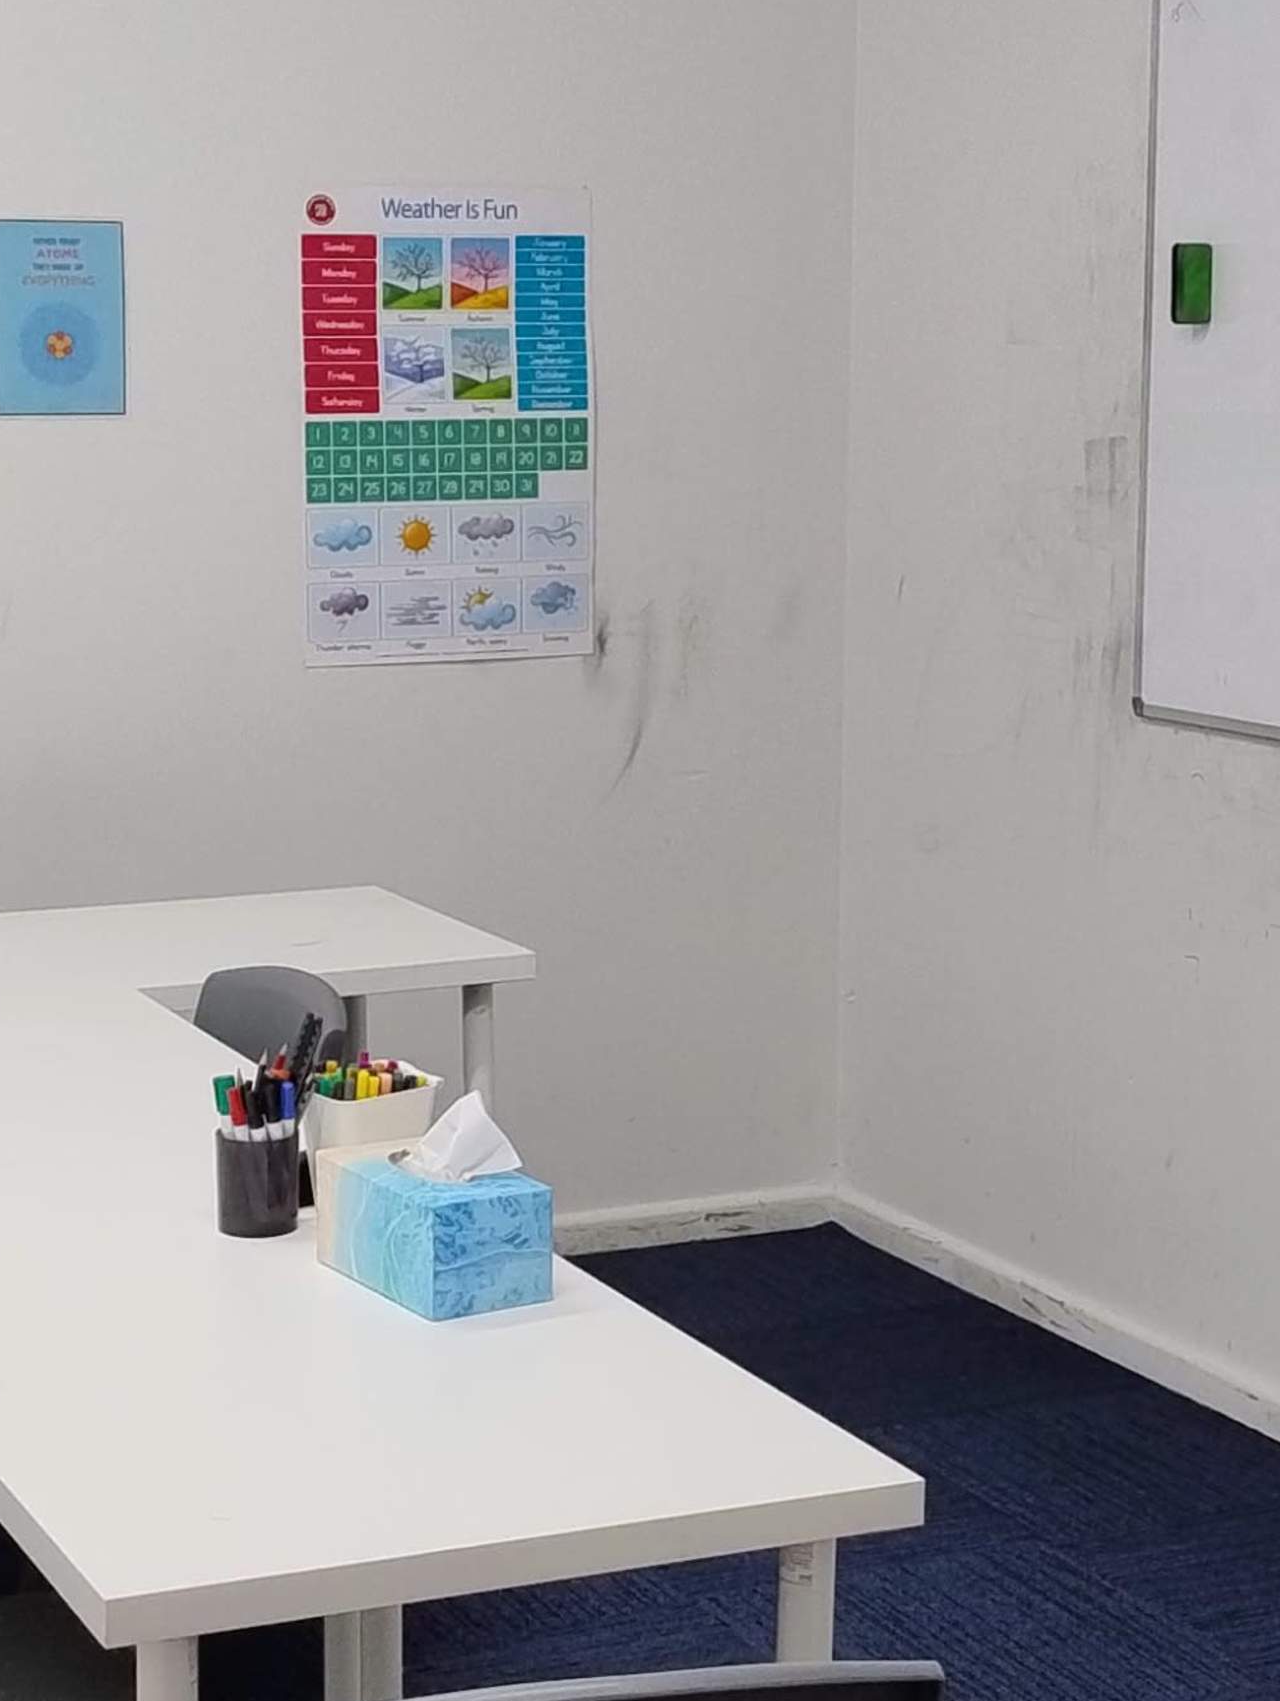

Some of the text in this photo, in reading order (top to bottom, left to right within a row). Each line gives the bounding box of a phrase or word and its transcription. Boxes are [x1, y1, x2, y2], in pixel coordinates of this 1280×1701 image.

[381, 197, 518, 220] Weather Is Fun
[341, 427, 349, 441] 2
[367, 426, 376, 440] 3
[393, 425, 403, 440] 4
[419, 425, 429, 439] 5
[444, 424, 454, 439] 6
[470, 425, 480, 439] 7
[497, 424, 505, 438] 8
[521, 423, 531, 438] 9
[544, 423, 558, 437] 10
[312, 455, 325, 469] 12
[391, 453, 404, 467] 15
[443, 452, 456, 468] 17
[518, 451, 535, 466] 20
[568, 449, 584, 464] 22
[311, 483, 328, 498] 23
[337, 482, 355, 497] 24
[363, 481, 381, 496] 25
[389, 481, 407, 496] 26
[416, 480, 434, 495] 27
[468, 479, 485, 493] 29
[492, 479, 511, 493] 30
[520, 479, 533, 492] 31
